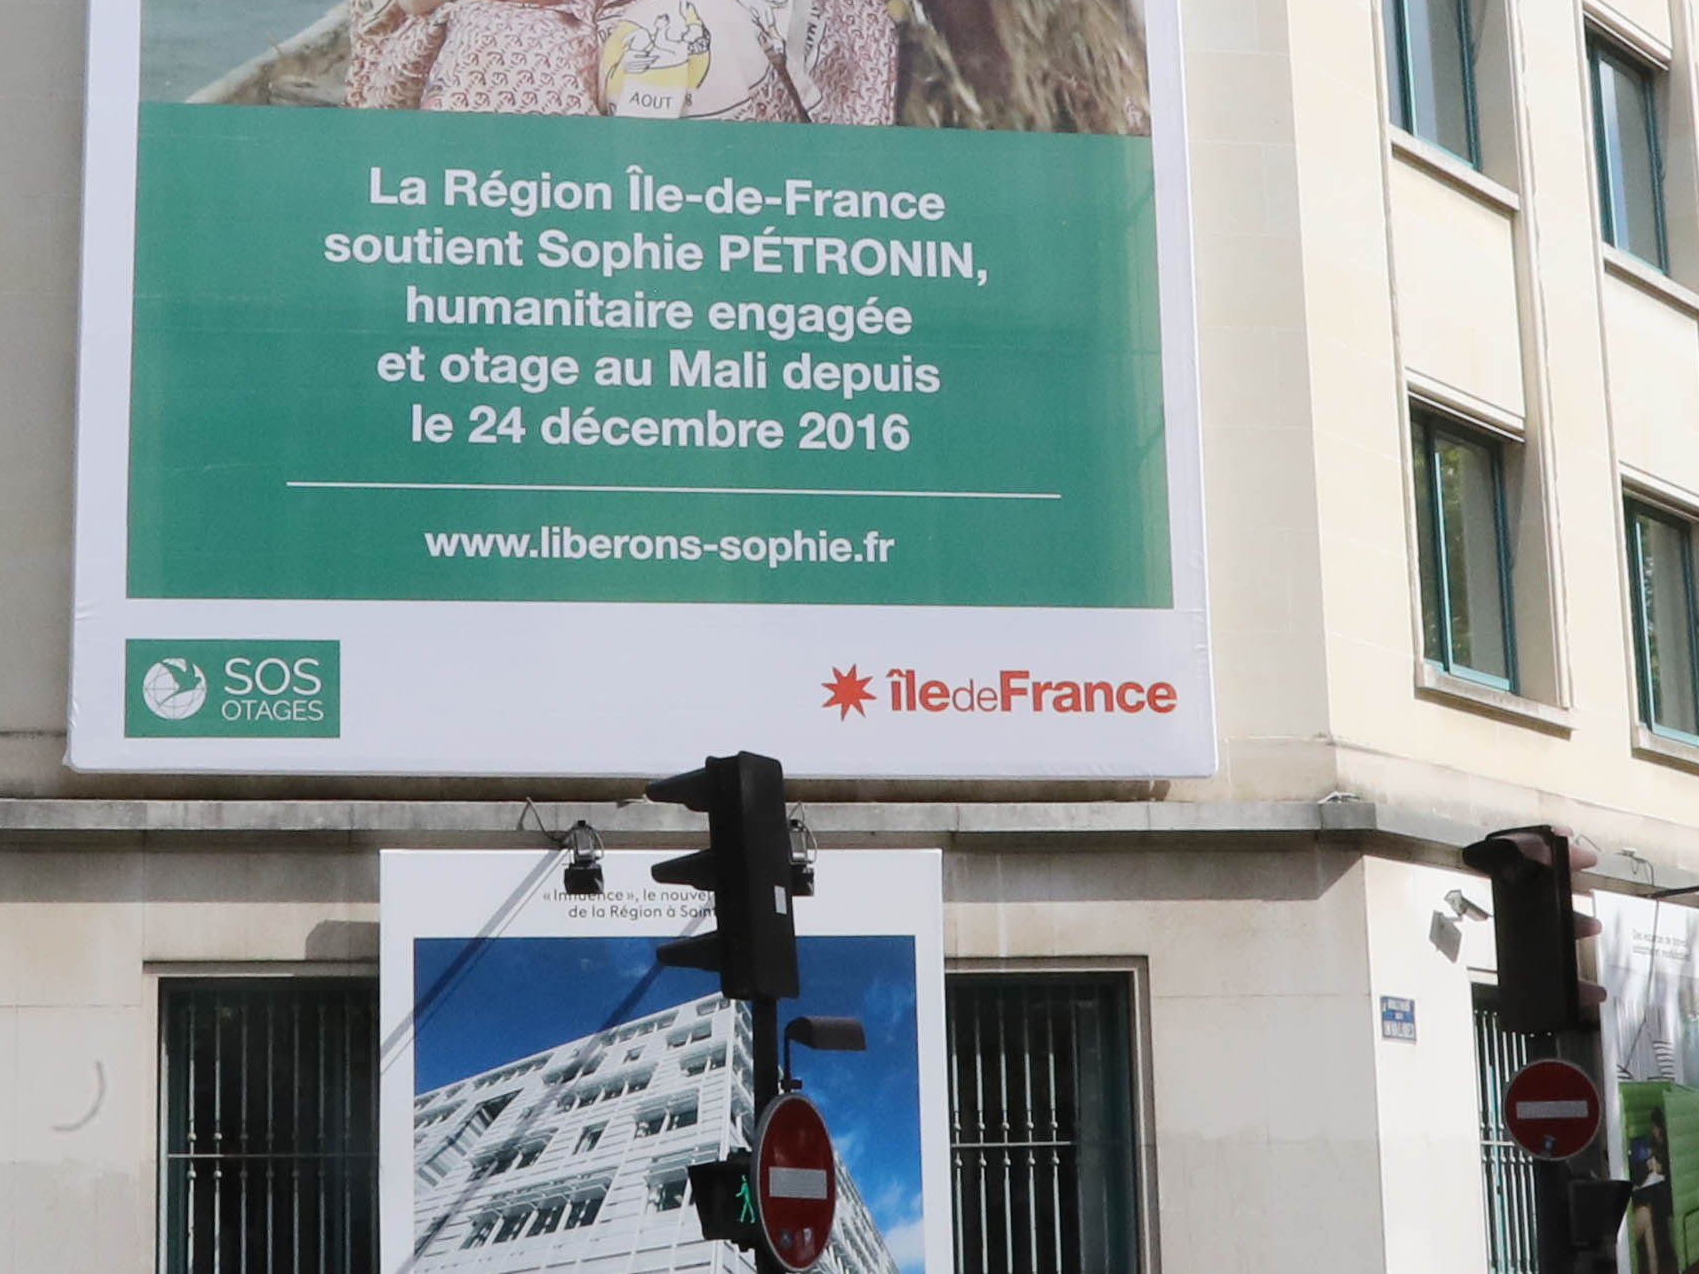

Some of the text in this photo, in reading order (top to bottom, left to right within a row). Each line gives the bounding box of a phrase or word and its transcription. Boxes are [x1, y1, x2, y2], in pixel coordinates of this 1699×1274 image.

[629, 91, 673, 109] AOUT
[370, 163, 946, 221] La Région Île-de-France
[324, 225, 988, 287] soutient Sophie PÉTRONIN,
[406, 285, 913, 343] humanitaire engagée
[377, 345, 941, 400] et otage au Mali depuis
[412, 403, 911, 452] le 24 décembre 2016
[424, 525, 896, 569] www.liberons-sophie.fr
[224, 657, 322, 695] SOS
[221, 699, 324, 721] OTAGES
[568, 905, 587, 918] de
[592, 905, 605, 918] la
[610, 905, 662, 920] Région
[666, 904, 675, 918] à
[643, 889, 656, 901] le
